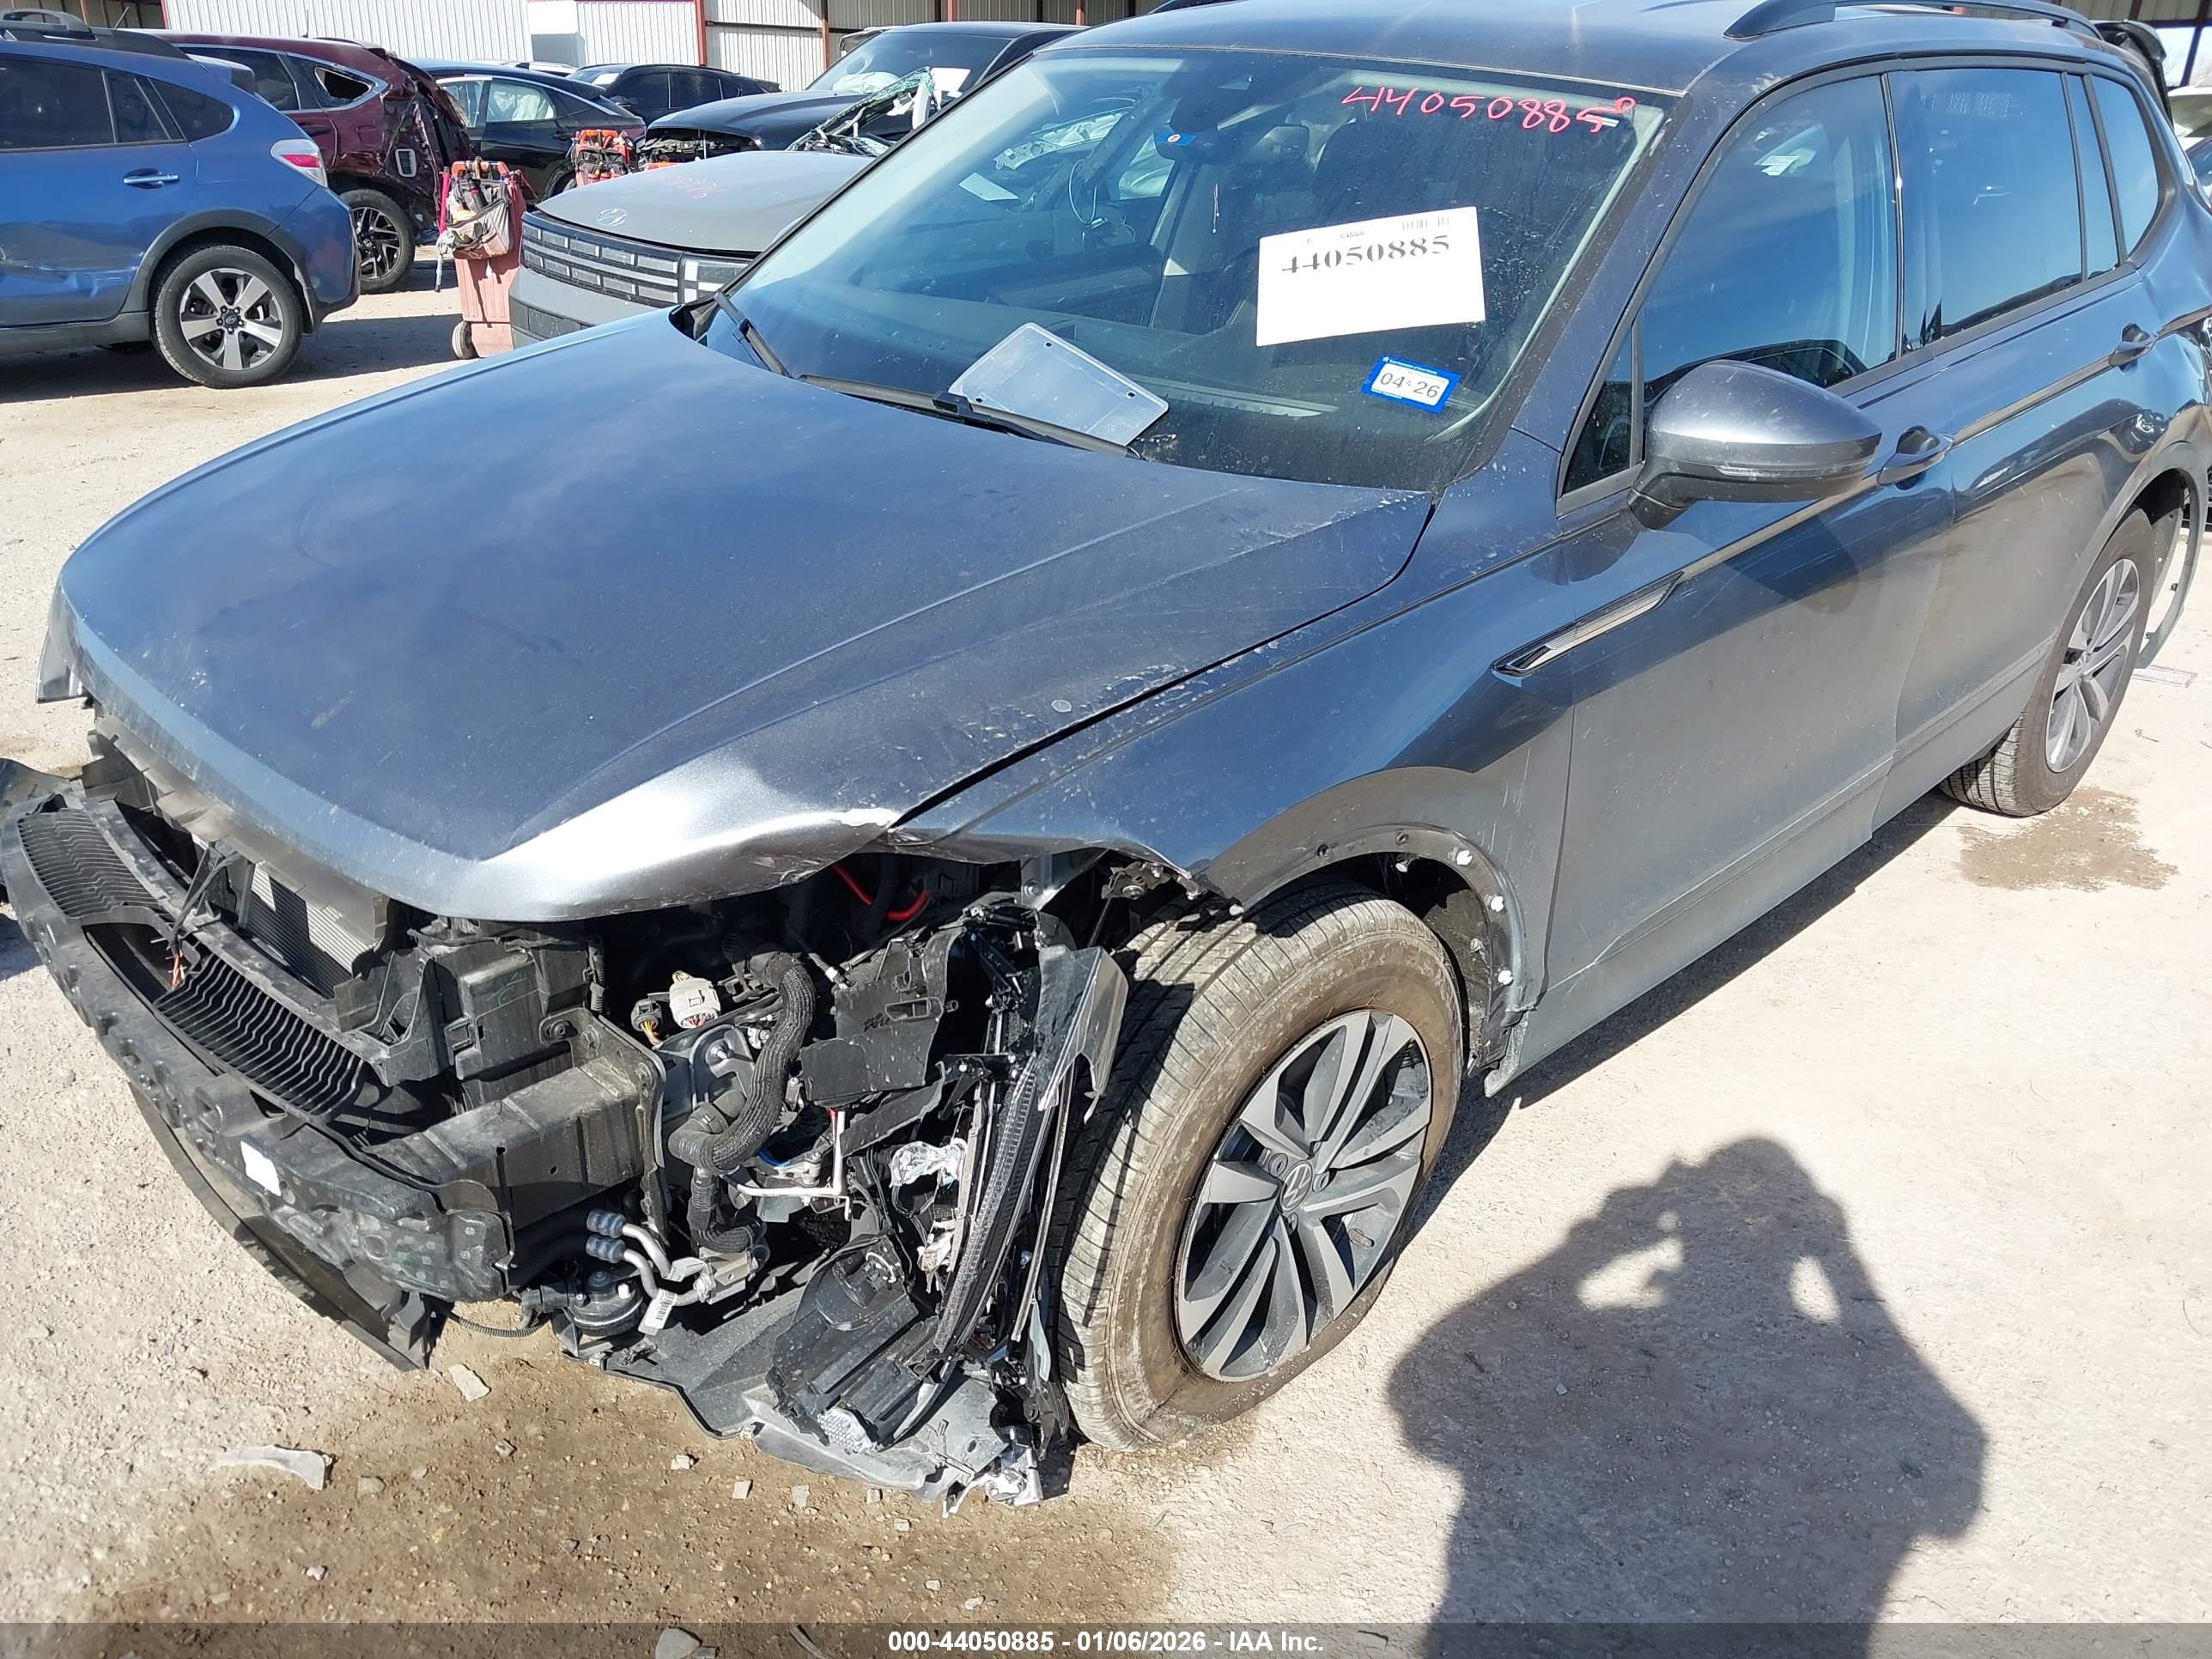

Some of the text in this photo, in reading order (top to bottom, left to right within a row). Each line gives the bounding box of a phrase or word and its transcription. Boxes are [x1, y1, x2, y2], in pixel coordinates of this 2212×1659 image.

[1281, 234, 1449, 274] 44050885
[1380, 372, 1406, 389] 04
[1413, 380, 1441, 398] 26
